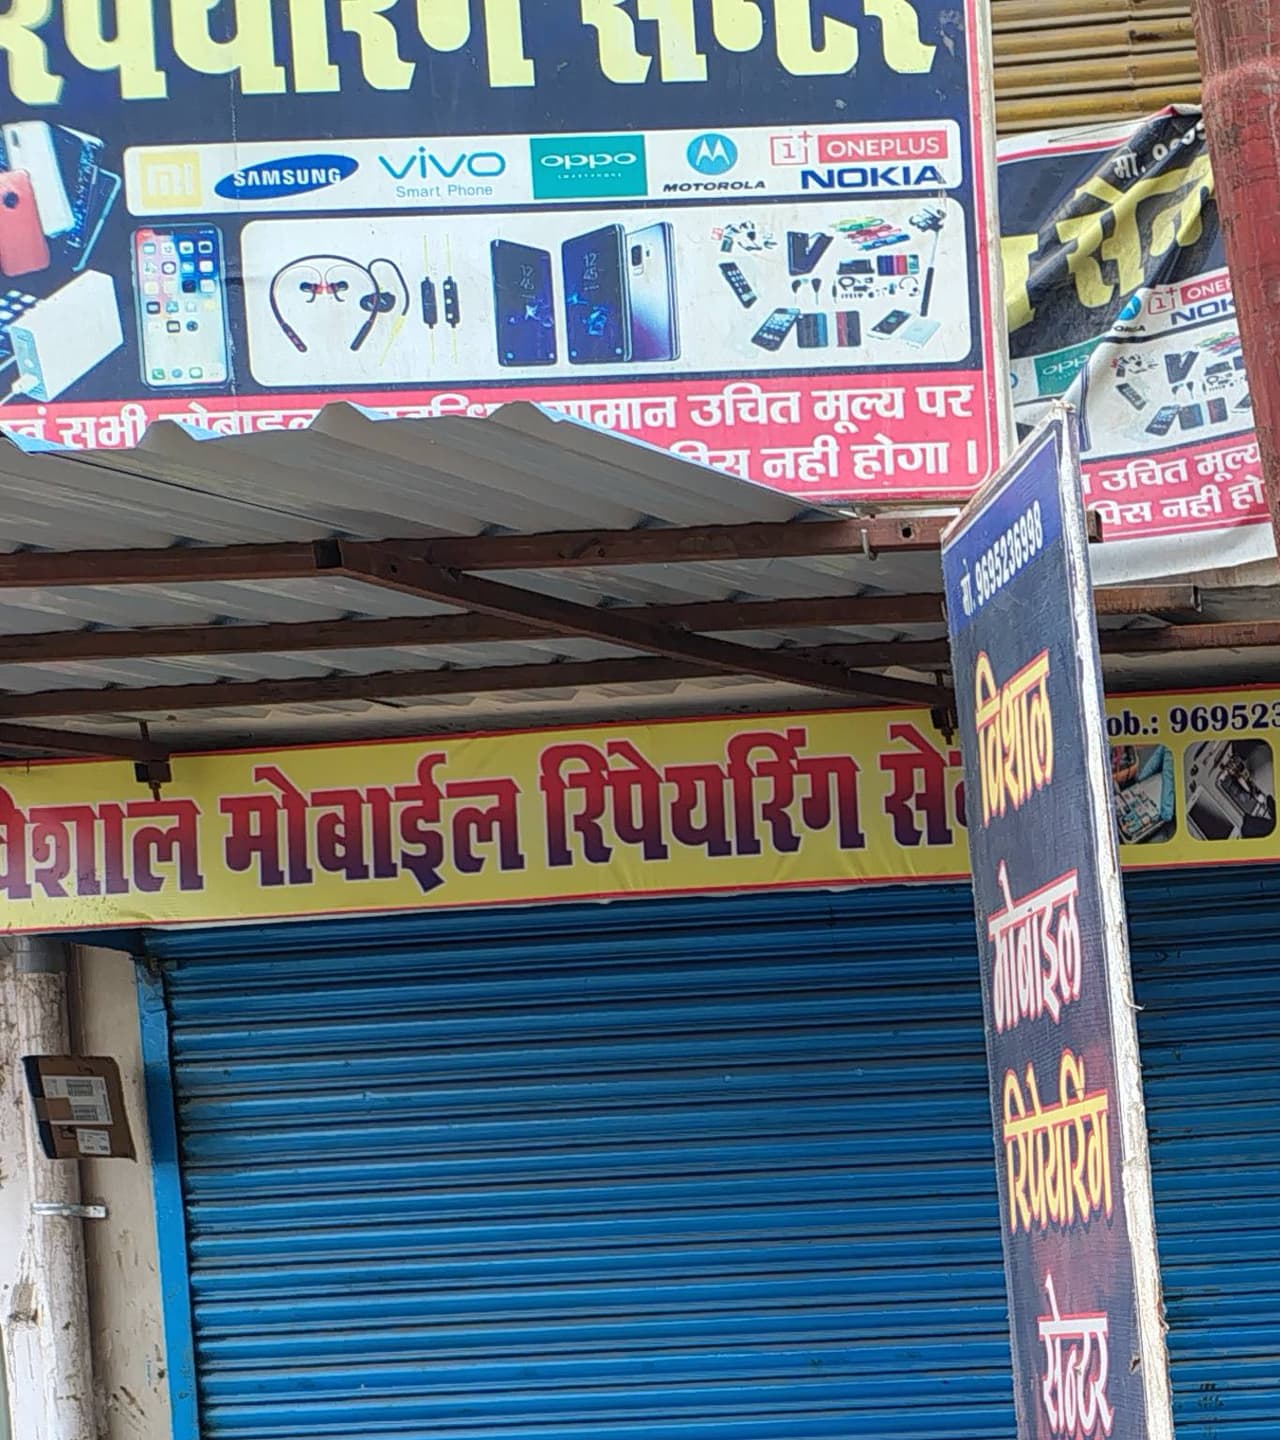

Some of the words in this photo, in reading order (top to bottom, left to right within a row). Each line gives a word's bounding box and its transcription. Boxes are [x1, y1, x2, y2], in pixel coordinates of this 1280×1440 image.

[232, 168, 342, 189] SAMSUNG
[378, 145, 506, 180] vivo
[540, 152, 637, 169] oppo
[826, 135, 940, 157] ONEPLUS
[396, 185, 441, 199] Smart
[447, 183, 494, 198] Phone
[663, 180, 767, 192] MOTOROLA
[800, 165, 947, 190] NOKIA
[688, 382, 801, 429] उचित
[812, 387, 905, 435] मूल्य
[914, 384, 975, 418] पर
[760, 437, 838, 482] नही
[852, 434, 950, 480] होगा
[1101, 457, 1188, 490] उचित
[1161, 486, 1222, 518] नही
[975, 500, 1044, 607] 9695236998
[974, 648, 1056, 829] विशाल
[1106, 709, 1159, 737] ob.:
[0, 785, 204, 899] शाल
[224, 752, 520, 892] मोबाईल
[540, 727, 866, 868] रिपेयरिंग
[986, 858, 1082, 1034] मोबाइल
[1037, 1270, 1113, 1436] सेन्टर
